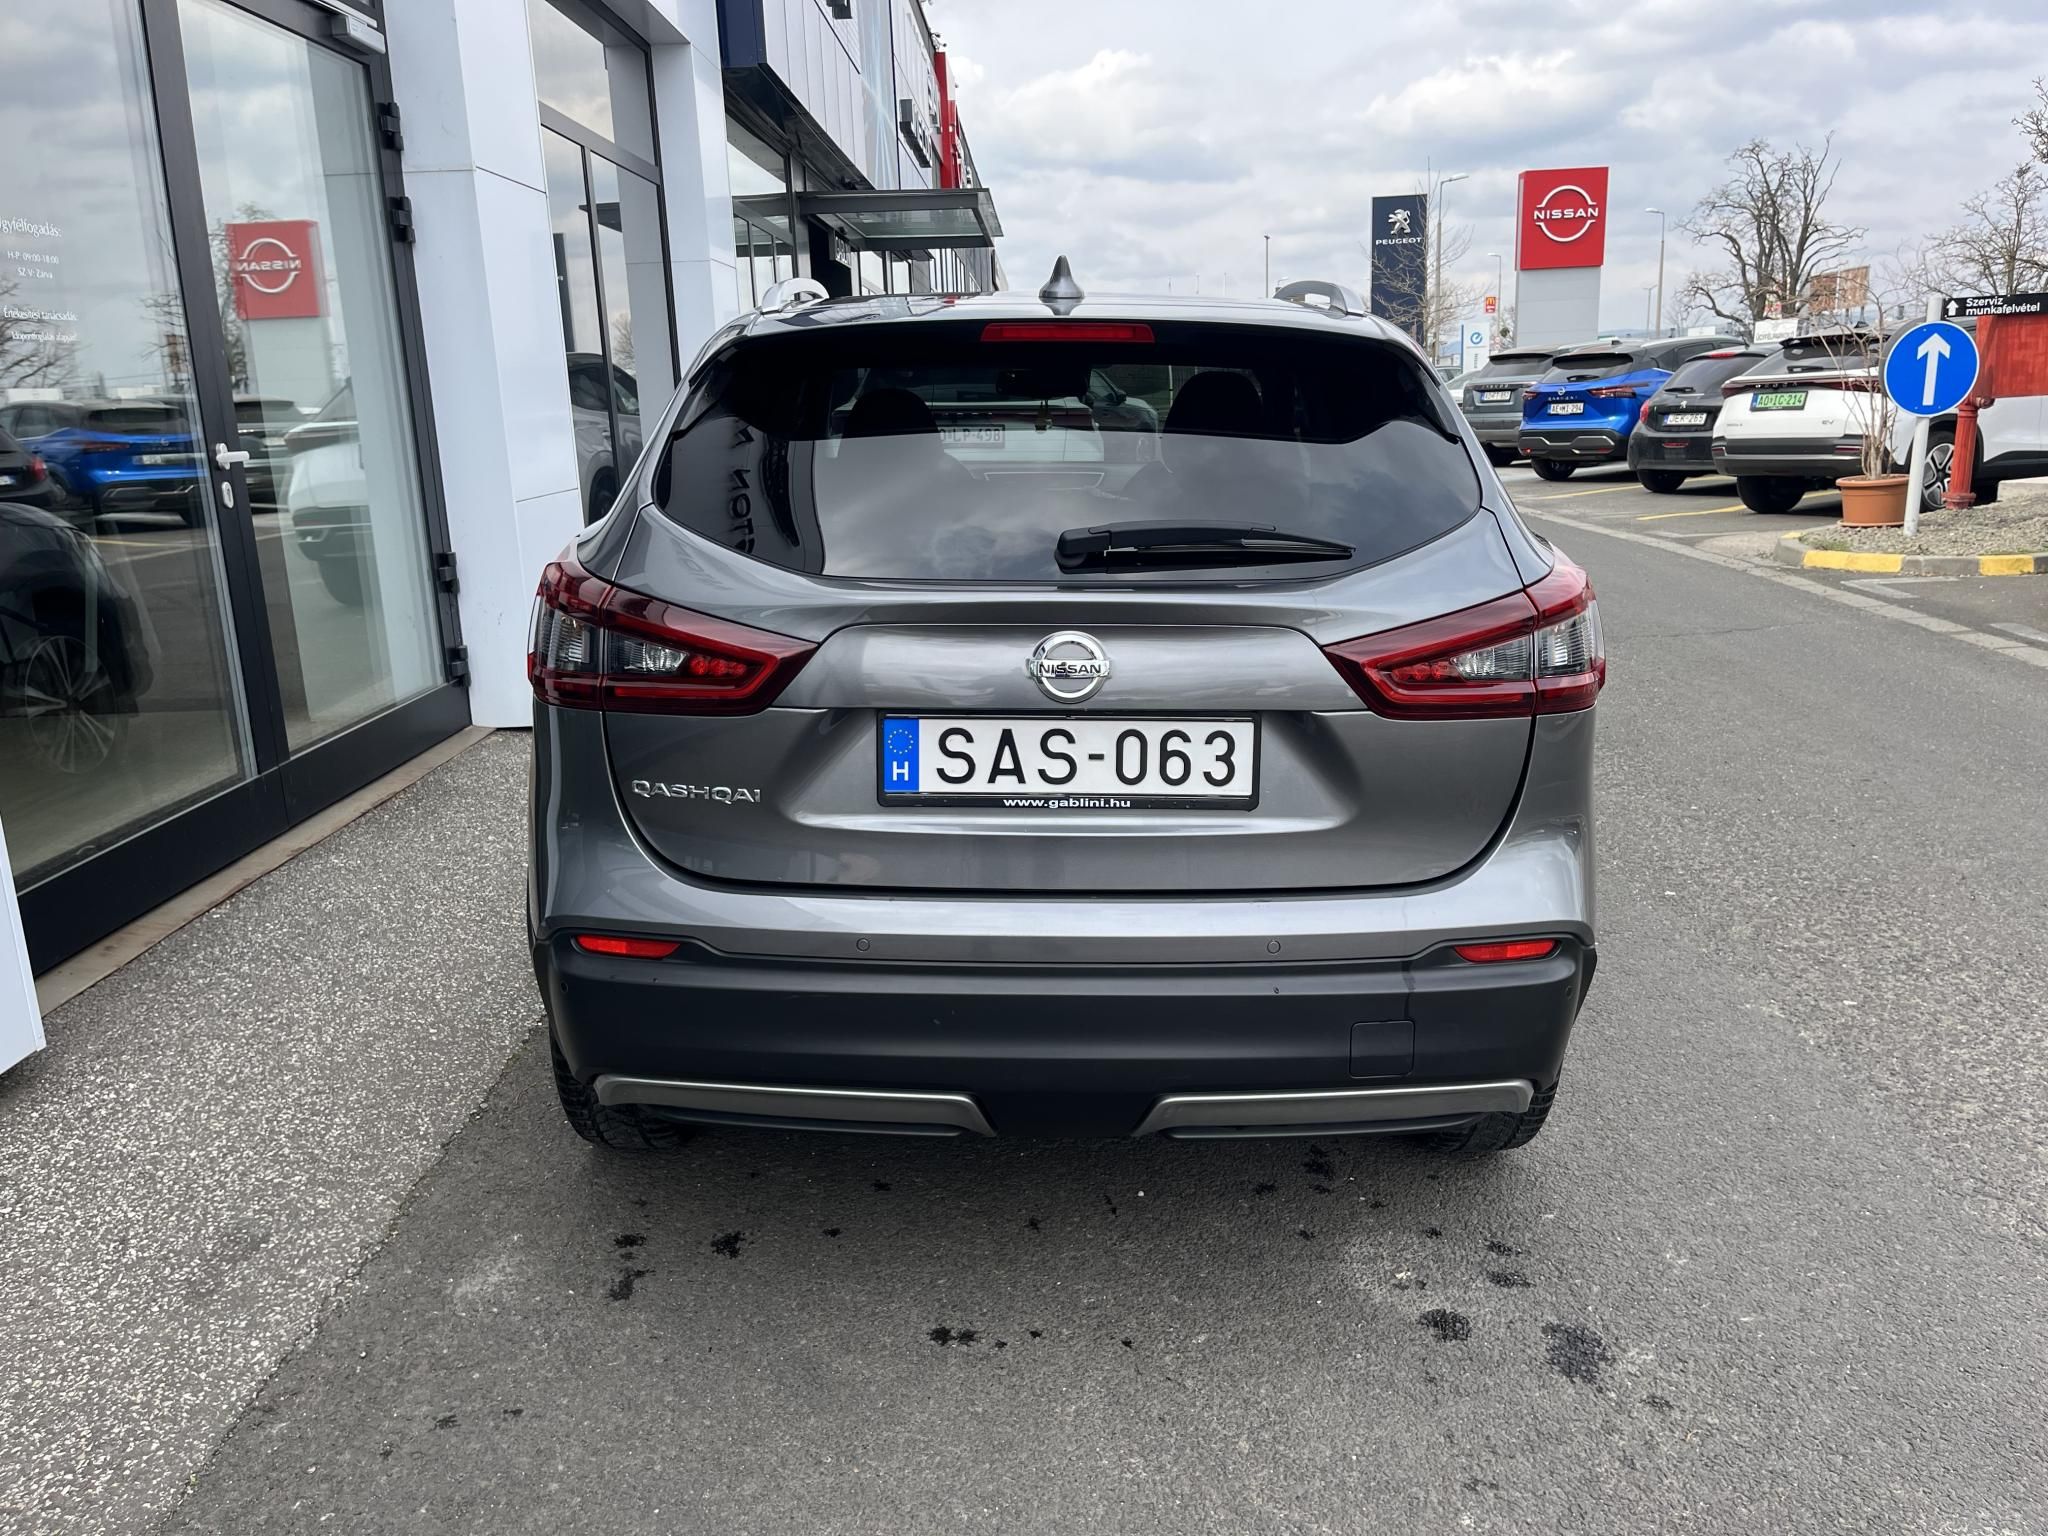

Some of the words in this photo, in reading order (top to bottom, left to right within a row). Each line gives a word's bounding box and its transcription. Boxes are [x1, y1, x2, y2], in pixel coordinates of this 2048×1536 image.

[1533, 207, 1598, 219] NISSAN
[0, 216, 61, 238] gyfélfogadás:
[1375, 237, 1422, 245] PEUGEOT
[1966, 296, 2004, 307] Szerviz
[1966, 302, 2040, 316] munkafelvétel
[1039, 663, 1101, 675] NISSAN
[892, 761, 909, 781] H
[936, 727, 1236, 786] SAS-063
[631, 779, 761, 804] QASHQAI
[1003, 797, 1131, 809] www.gablini.hu
